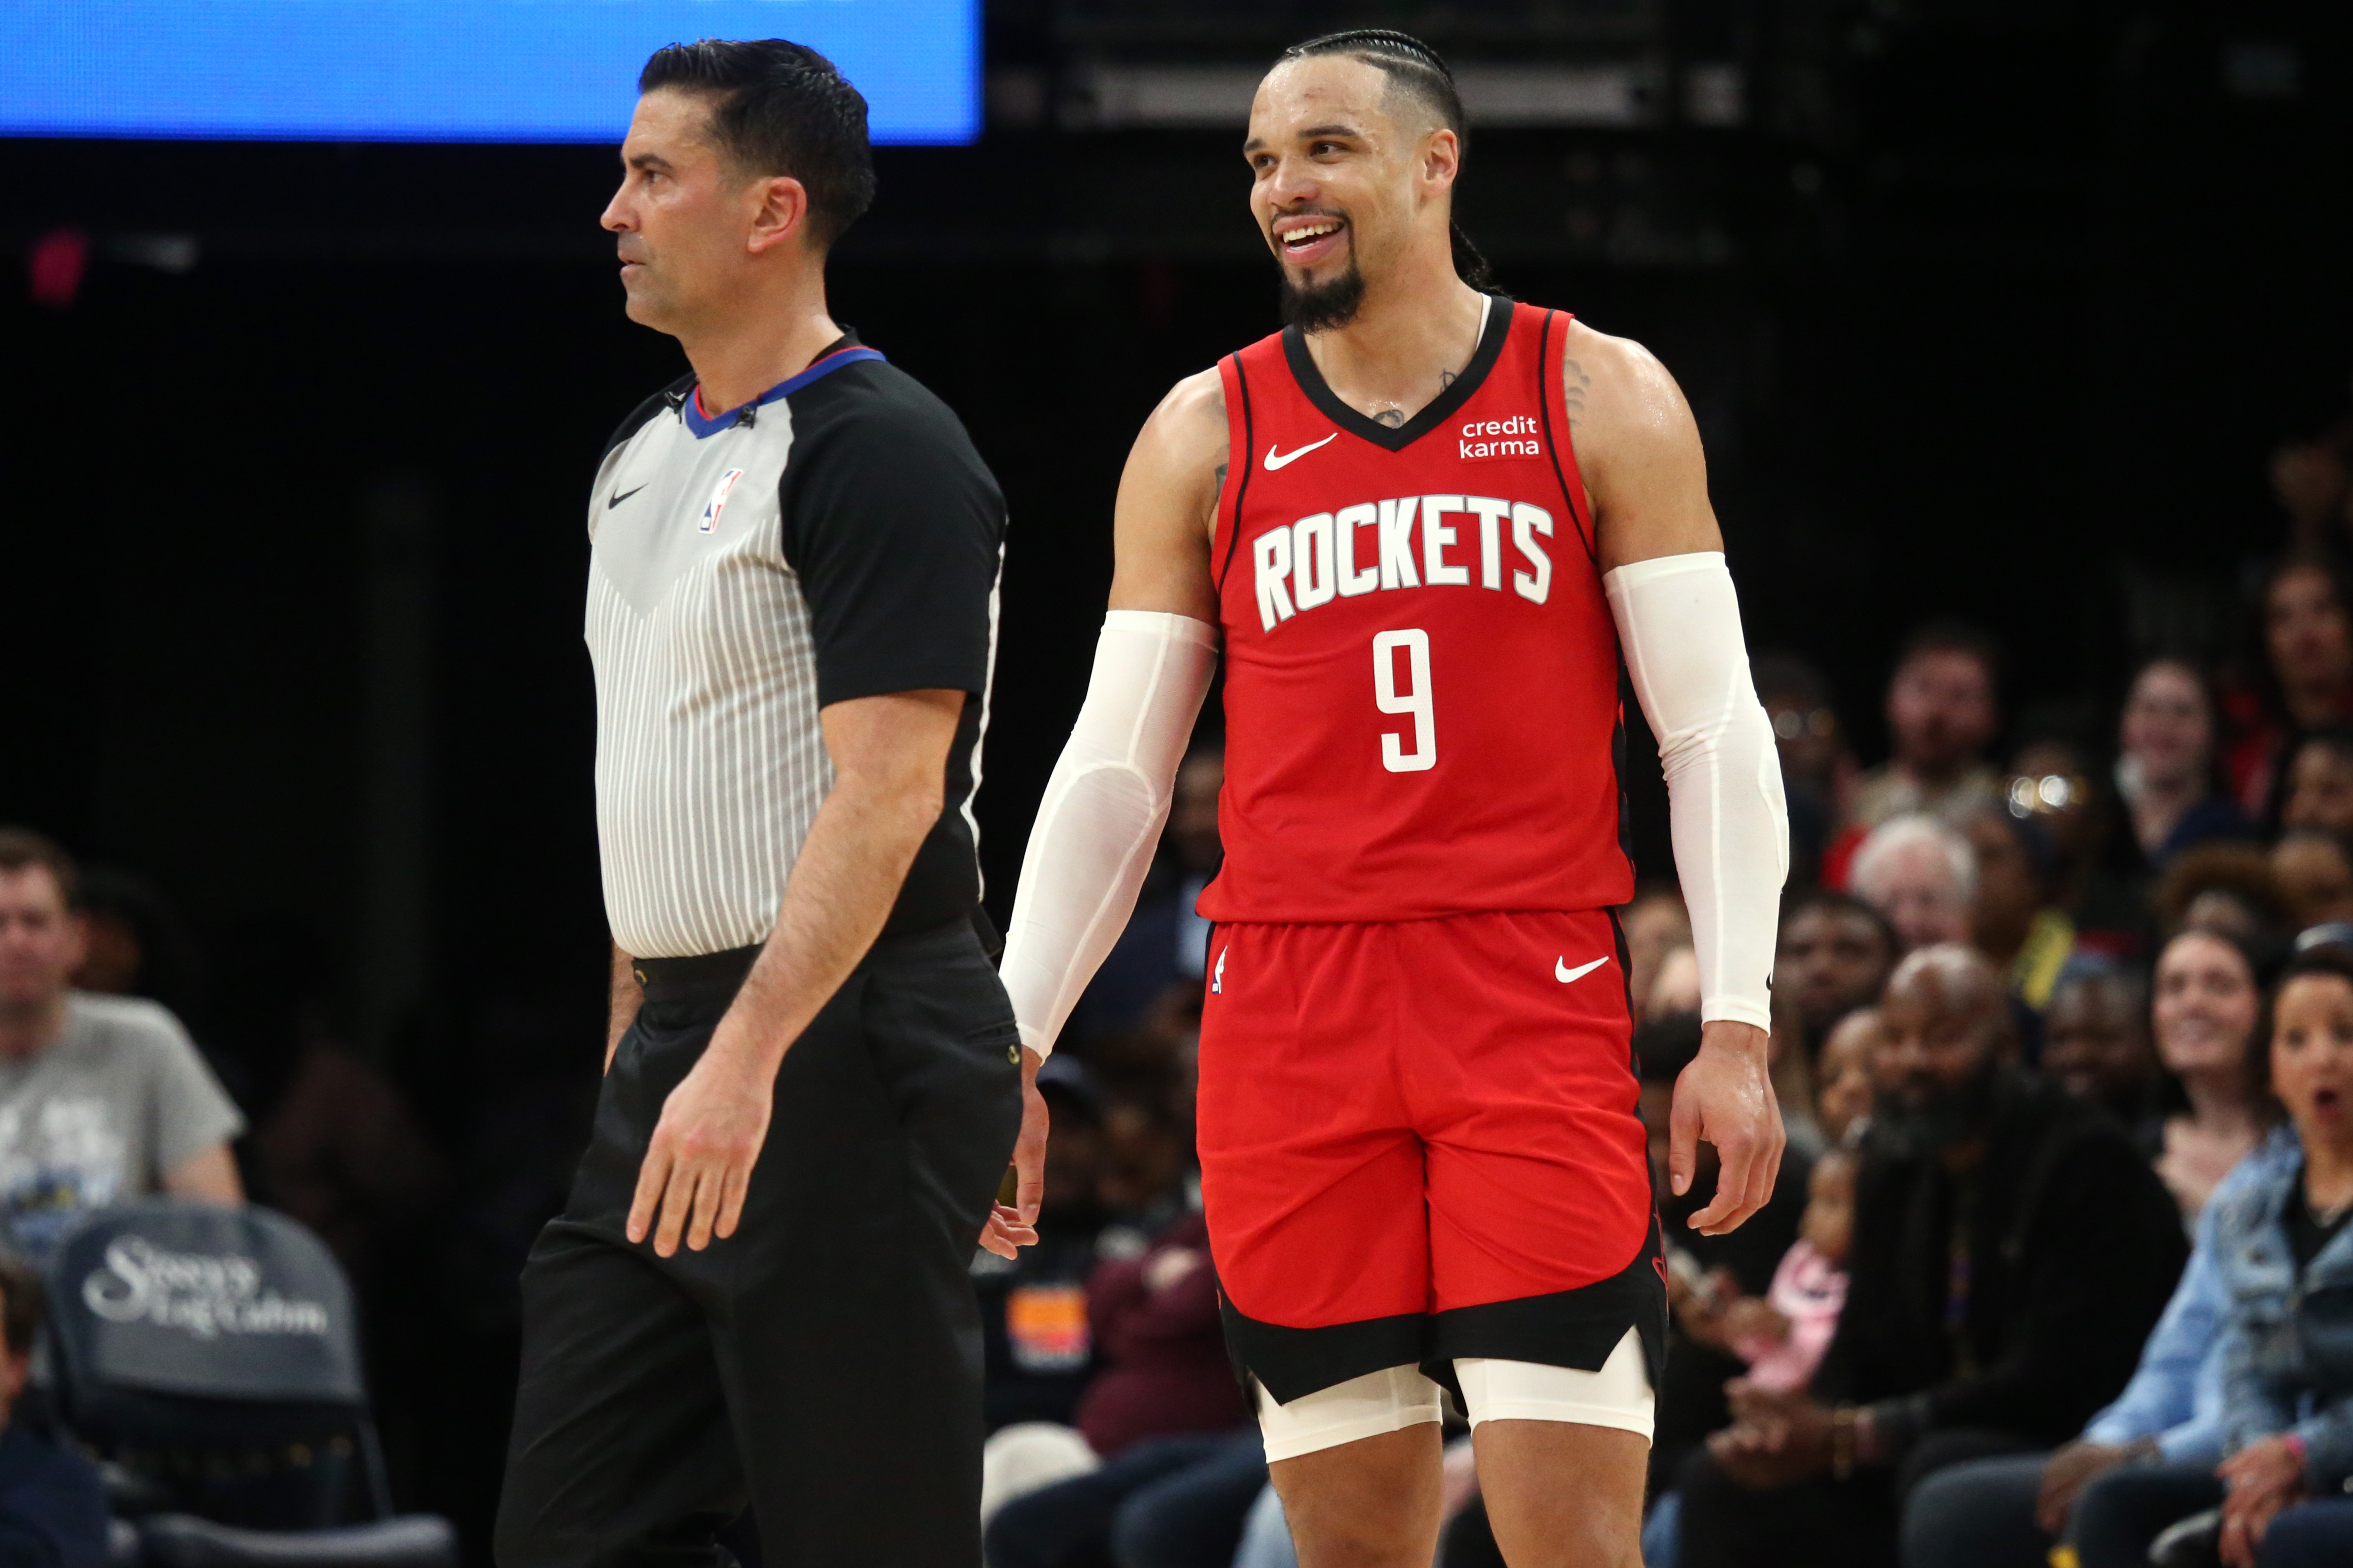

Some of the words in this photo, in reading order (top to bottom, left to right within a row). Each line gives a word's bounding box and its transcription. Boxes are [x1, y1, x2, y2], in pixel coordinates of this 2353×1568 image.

[1459, 439, 1540, 460] karma
[1462, 416, 1538, 437] credit
[1253, 494, 1554, 634] ROCKETS
[1372, 628, 1437, 773] 9
